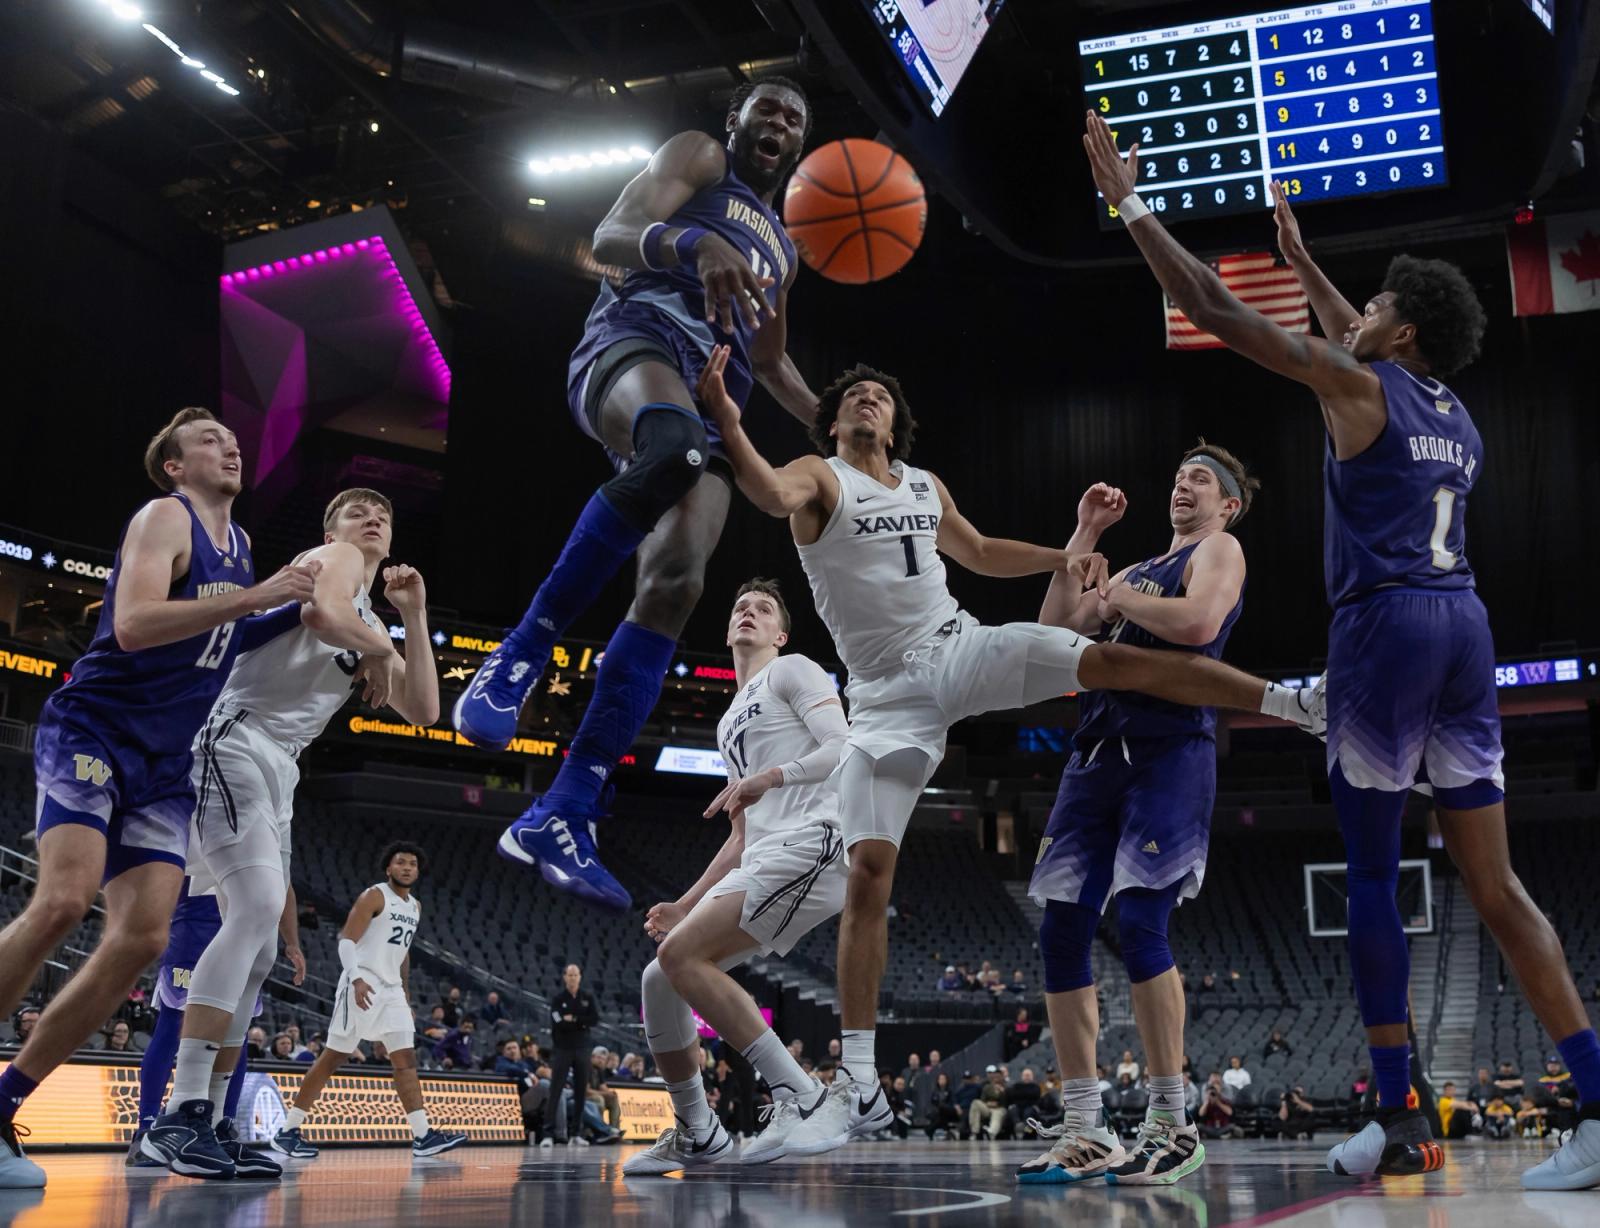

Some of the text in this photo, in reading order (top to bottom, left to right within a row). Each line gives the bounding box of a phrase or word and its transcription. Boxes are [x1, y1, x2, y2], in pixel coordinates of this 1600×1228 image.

[1256, 13, 1290, 24] PLAYER
[1304, 8, 1323, 17] PTS
[1338, 3, 1356, 12] REB
[1083, 20, 1242, 51] PLAYER PTS REB AST FLS
[1269, 13, 1421, 50] 1 12 8 1 2
[1095, 39, 1241, 76] 1 15 7 2 4
[1274, 50, 1424, 87] 5 16 4 1 2
[1099, 76, 1245, 113] 3 0 2 1 2
[1277, 87, 1427, 123] 9 7 8 3 3
[1142, 126, 1153, 143] 2
[1174, 121, 1186, 138] 3
[1206, 117, 1218, 133] 0
[1237, 113, 1248, 130] 3
[1277, 124, 1431, 159] 11 4 9 0 2
[1146, 148, 1252, 178] 2 6 2 3
[1280, 162, 1434, 196] 13 7 3 0 3
[1146, 196, 1166, 212] 16
[1182, 192, 1193, 209] 2
[1214, 188, 1226, 204] 0
[1244, 184, 1256, 201] 3
[726, 198, 789, 286] WASHINGTON
[1408, 435, 1464, 468] BROOKS
[852, 514, 938, 536] XAVIER
[1430, 486, 1458, 572] 1
[0, 540, 33, 561] 2019
[900, 534, 920, 577] 1
[194, 620, 237, 670] 13
[1495, 666, 1519, 687] 58
[1519, 661, 1551, 685] W
[349, 715, 417, 737] Continental
[427, 728, 453, 742] TIRE
[73, 753, 113, 787] W
[387, 925, 413, 948] 20
[631, 1122, 662, 1135] TIRE
